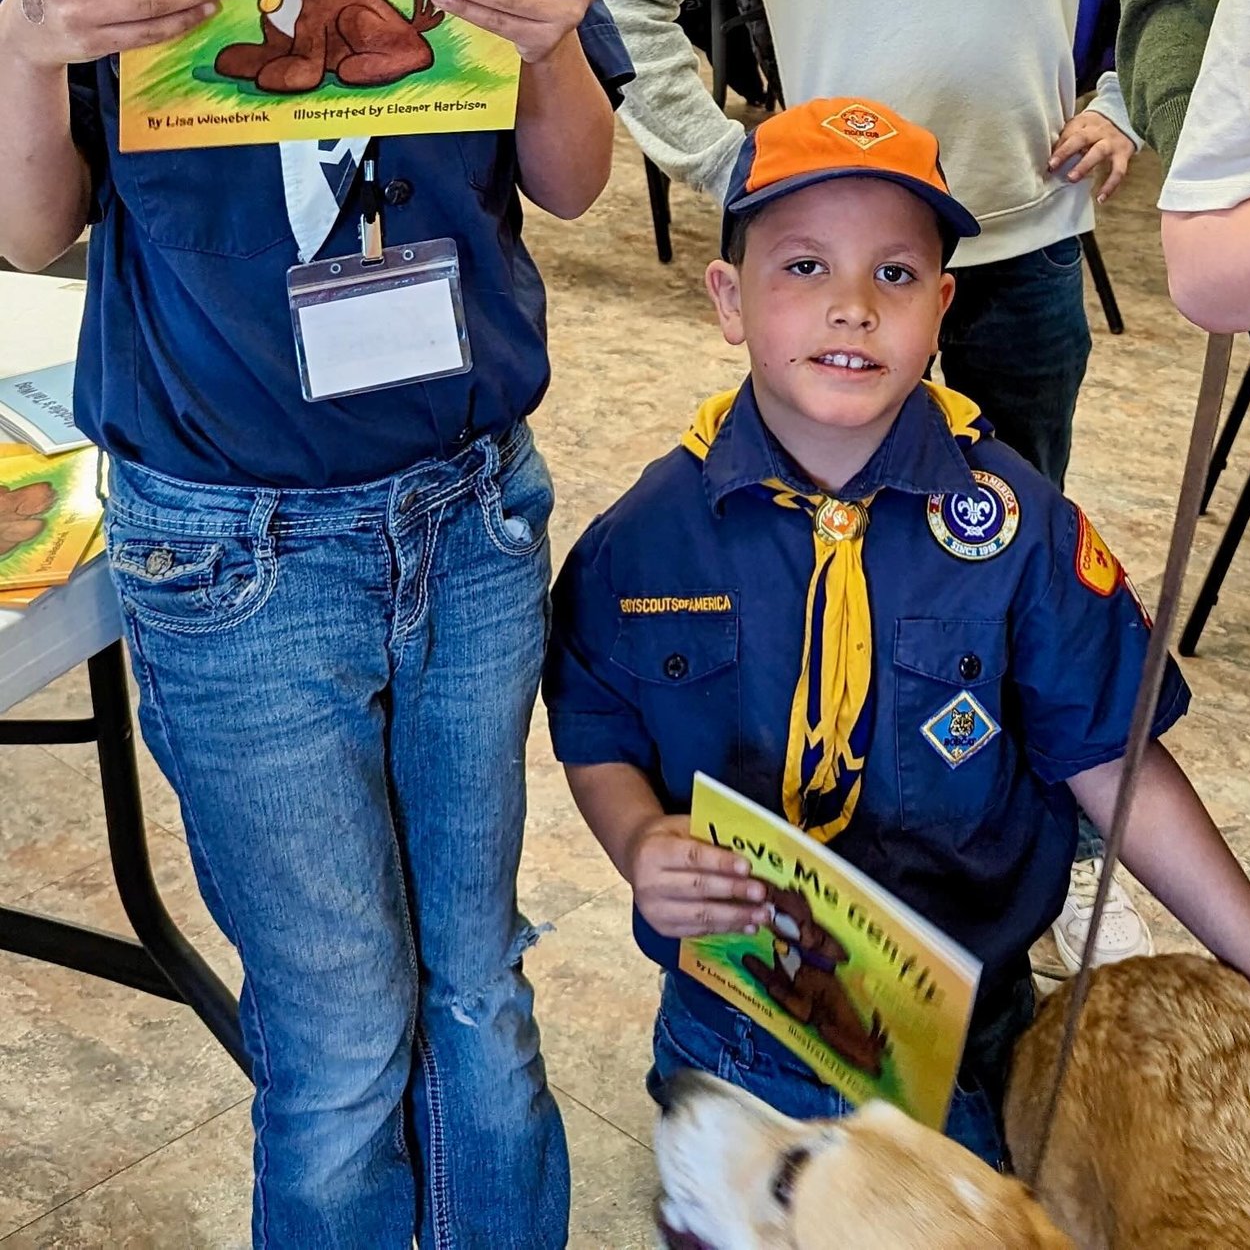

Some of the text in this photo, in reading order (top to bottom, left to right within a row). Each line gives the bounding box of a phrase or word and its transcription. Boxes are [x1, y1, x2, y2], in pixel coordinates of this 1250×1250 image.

[147, 116, 162, 130] By
[166, 116, 194, 128] Lisa
[294, 106, 365, 121] Illustrated
[369, 104, 384, 118] by
[387, 103, 431, 114] Eleanor
[434, 101, 487, 113] Harbison
[982, 475, 1015, 509] AMERICA
[950, 541, 978, 556] SINCE
[708, 822, 783, 872] Love
[794, 858, 838, 907] Me
